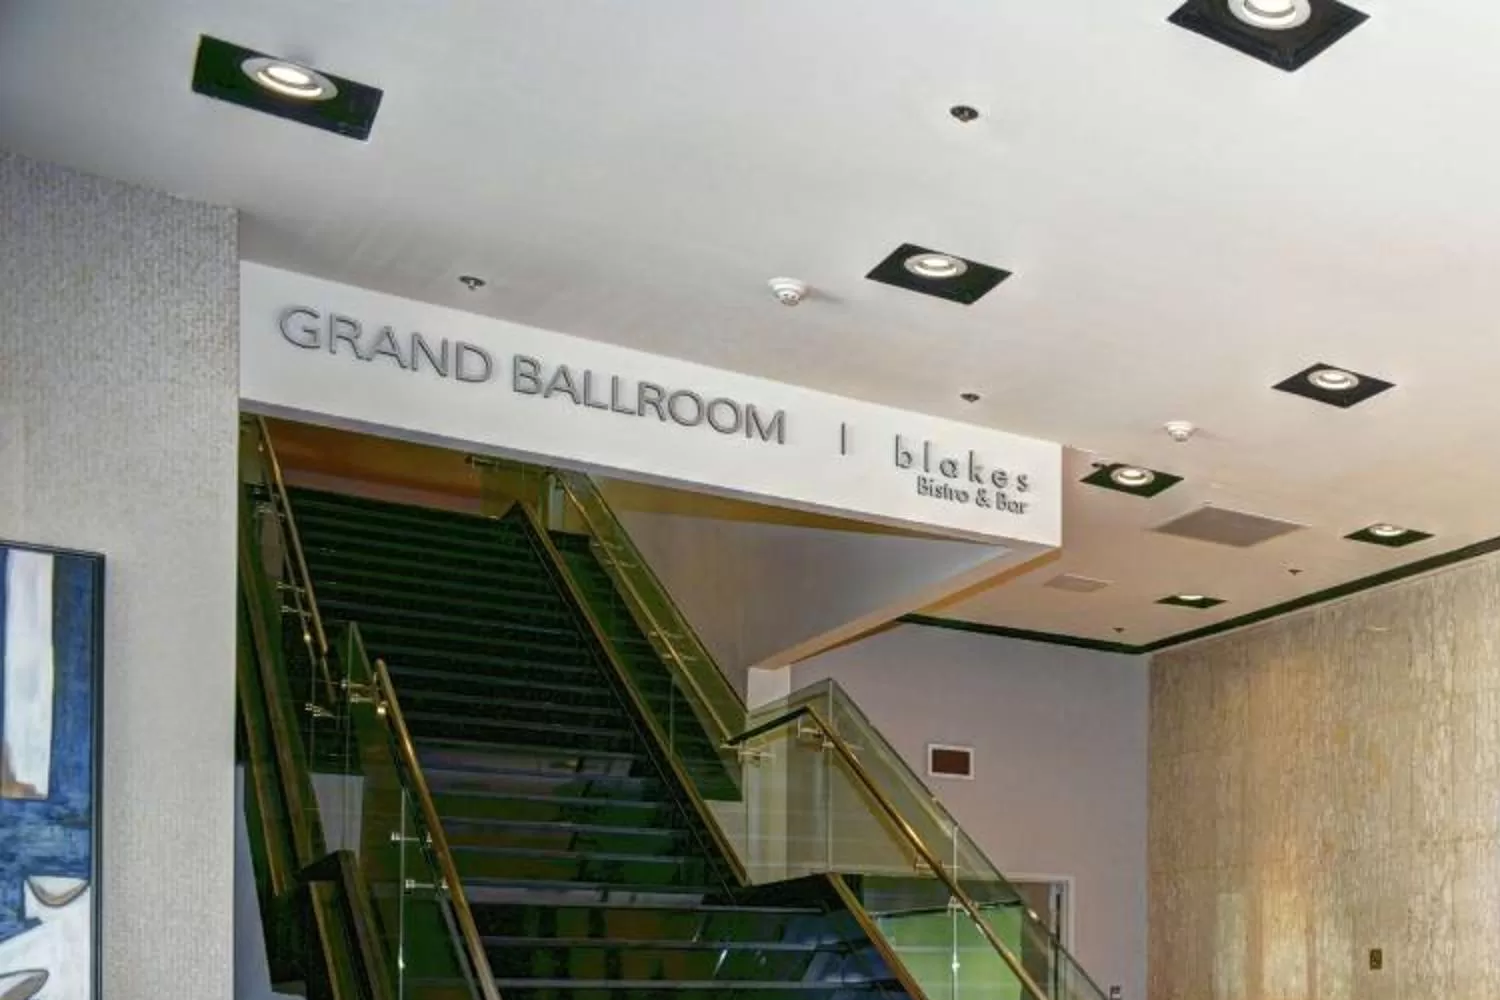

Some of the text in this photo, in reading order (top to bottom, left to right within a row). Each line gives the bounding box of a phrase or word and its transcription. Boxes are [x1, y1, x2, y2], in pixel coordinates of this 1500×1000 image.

[278, 305, 493, 383] GRAND
[512, 354, 787, 445] BALLROOM
[894, 433, 1030, 493] blakes
[916, 475, 1029, 515] Bistro & Bar
